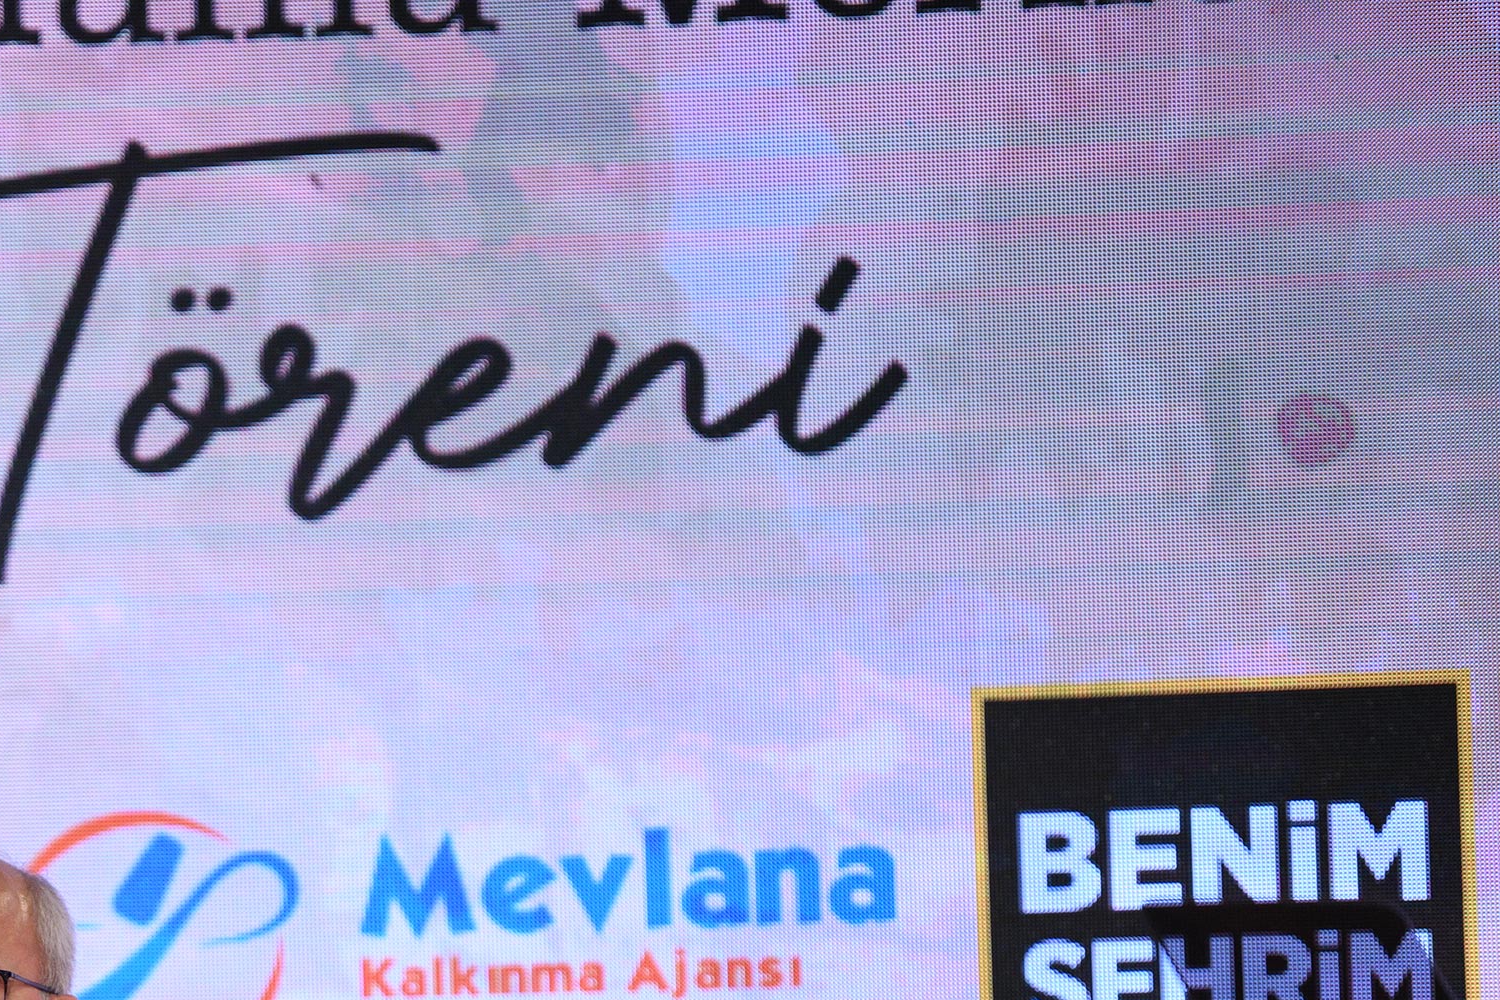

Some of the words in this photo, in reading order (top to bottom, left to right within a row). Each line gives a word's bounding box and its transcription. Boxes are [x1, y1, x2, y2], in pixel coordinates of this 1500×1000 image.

[360, 827, 898, 938] Mevlana
[361, 954, 605, 1000] Kalkınma
[629, 948, 803, 1000] Ajansı
